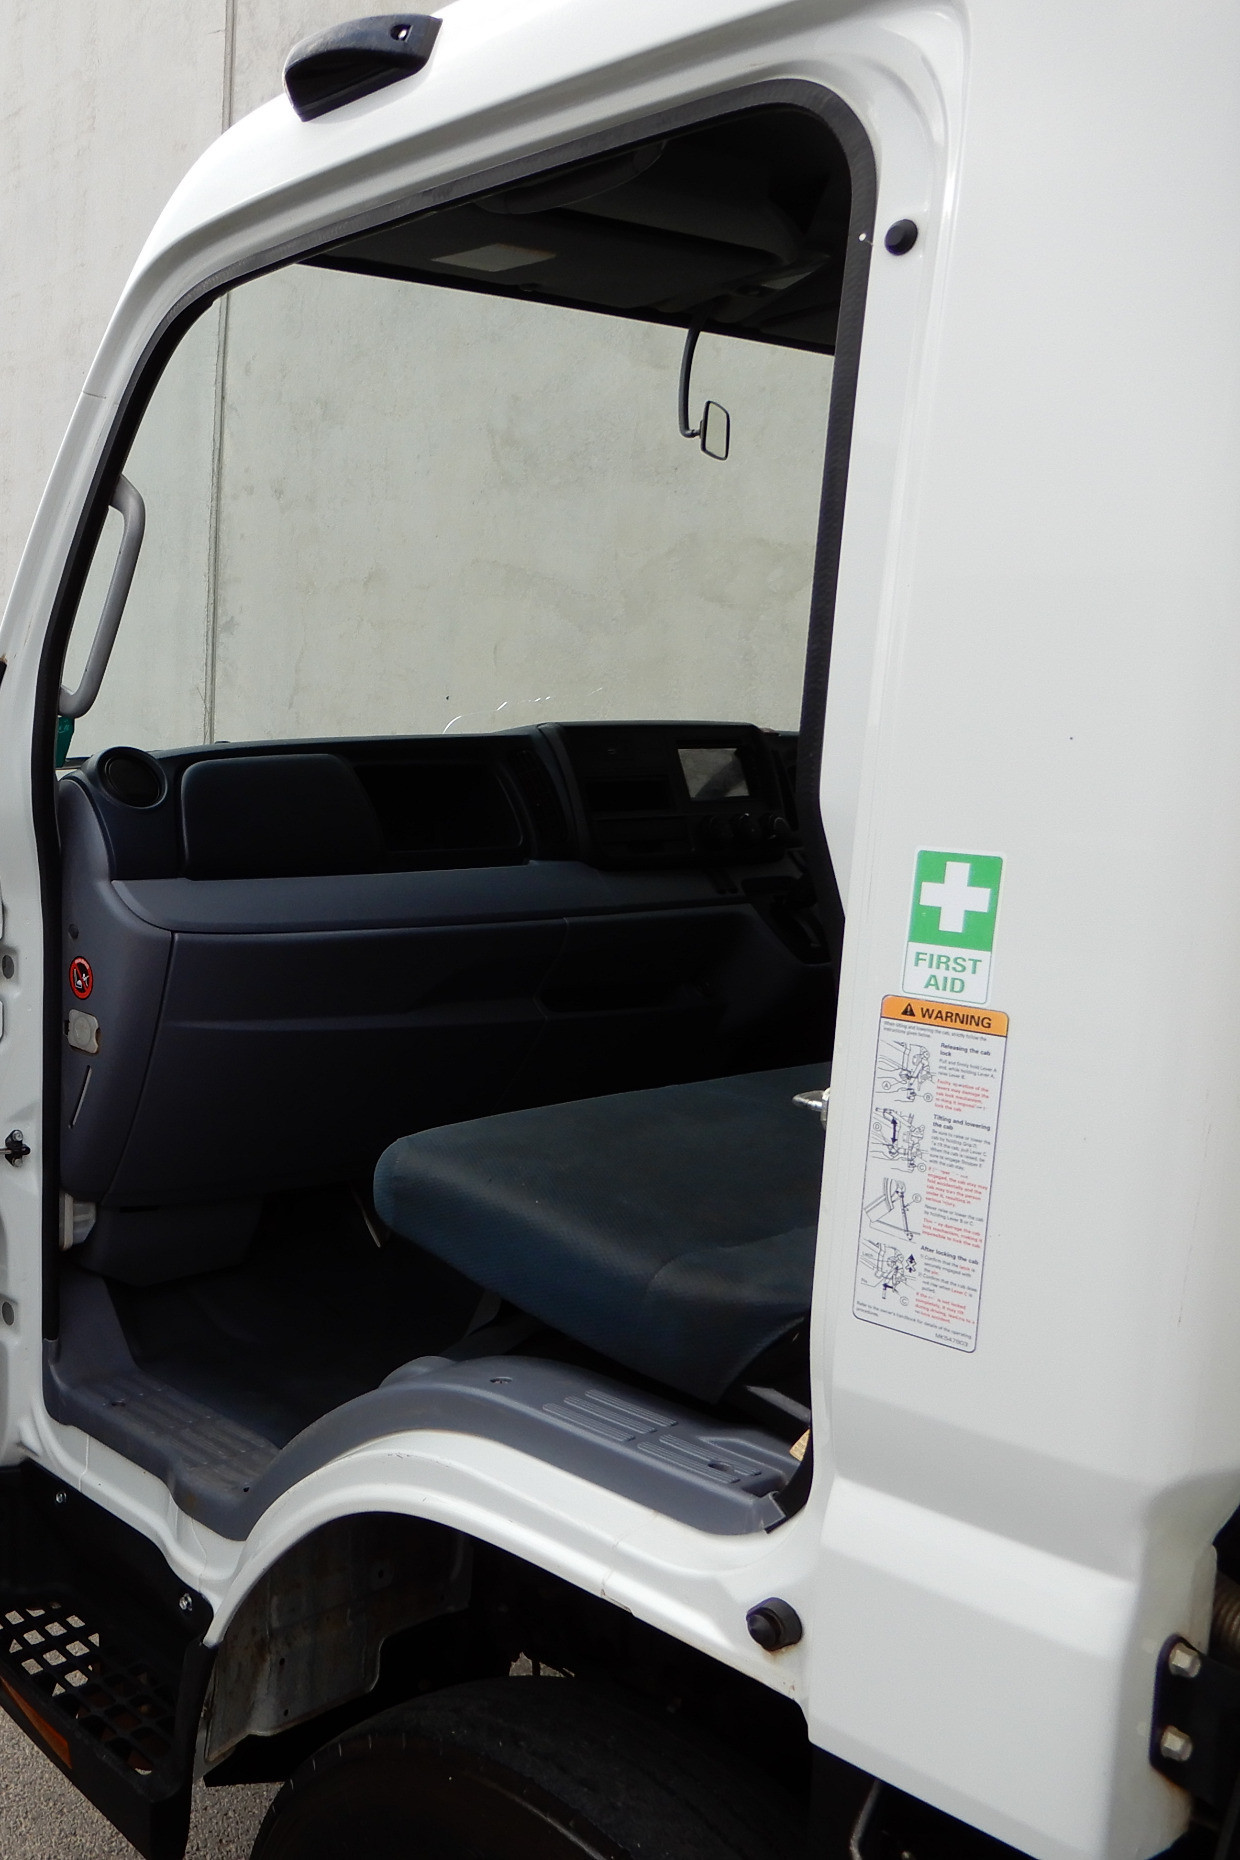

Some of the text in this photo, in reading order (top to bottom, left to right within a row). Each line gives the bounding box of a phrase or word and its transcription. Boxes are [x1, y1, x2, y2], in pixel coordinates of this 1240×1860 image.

[914, 951, 982, 975] FIRST
[923, 974, 966, 994] AID
[920, 1007, 992, 1029] WARNING
[940, 1043, 991, 1057] Releasing the cab
[933, 1114, 991, 1131] Tilting and lowering
[921, 1245, 934, 1254] After
[935, 1249, 956, 1260] locking
[968, 1258, 979, 1266] cab
